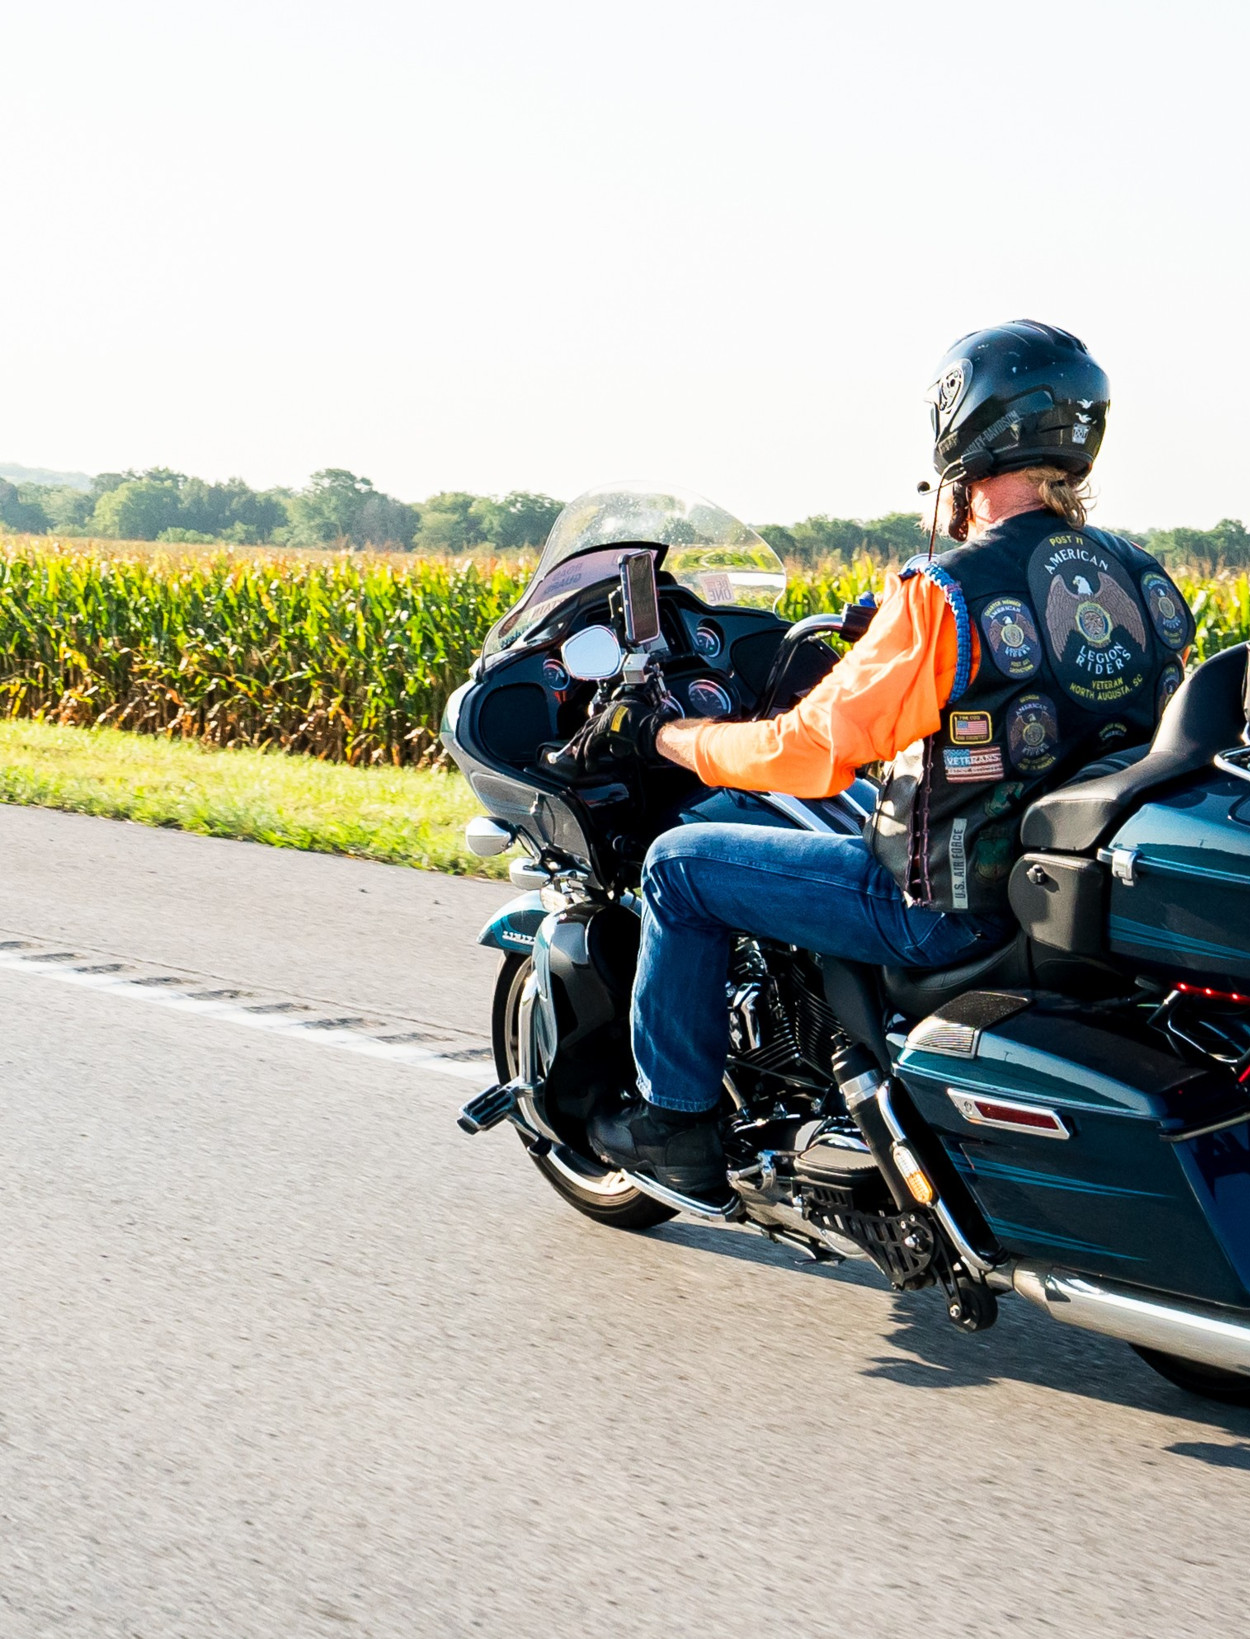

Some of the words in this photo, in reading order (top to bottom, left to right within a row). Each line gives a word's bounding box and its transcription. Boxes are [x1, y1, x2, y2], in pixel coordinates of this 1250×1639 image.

[1049, 535, 1072, 547] POST
[1044, 548, 1108, 575] AMERICAN
[1076, 649, 1131, 675] RIDERS
[1080, 642, 1123, 664] LEGION
[1070, 682, 1095, 699] NORTH
[1132, 674, 1143, 687] SC
[1092, 677, 1123, 690] VETERAN
[946, 753, 999, 767] VETERANS
[950, 828, 964, 859] FORCE
[953, 861, 965, 878] AIR
